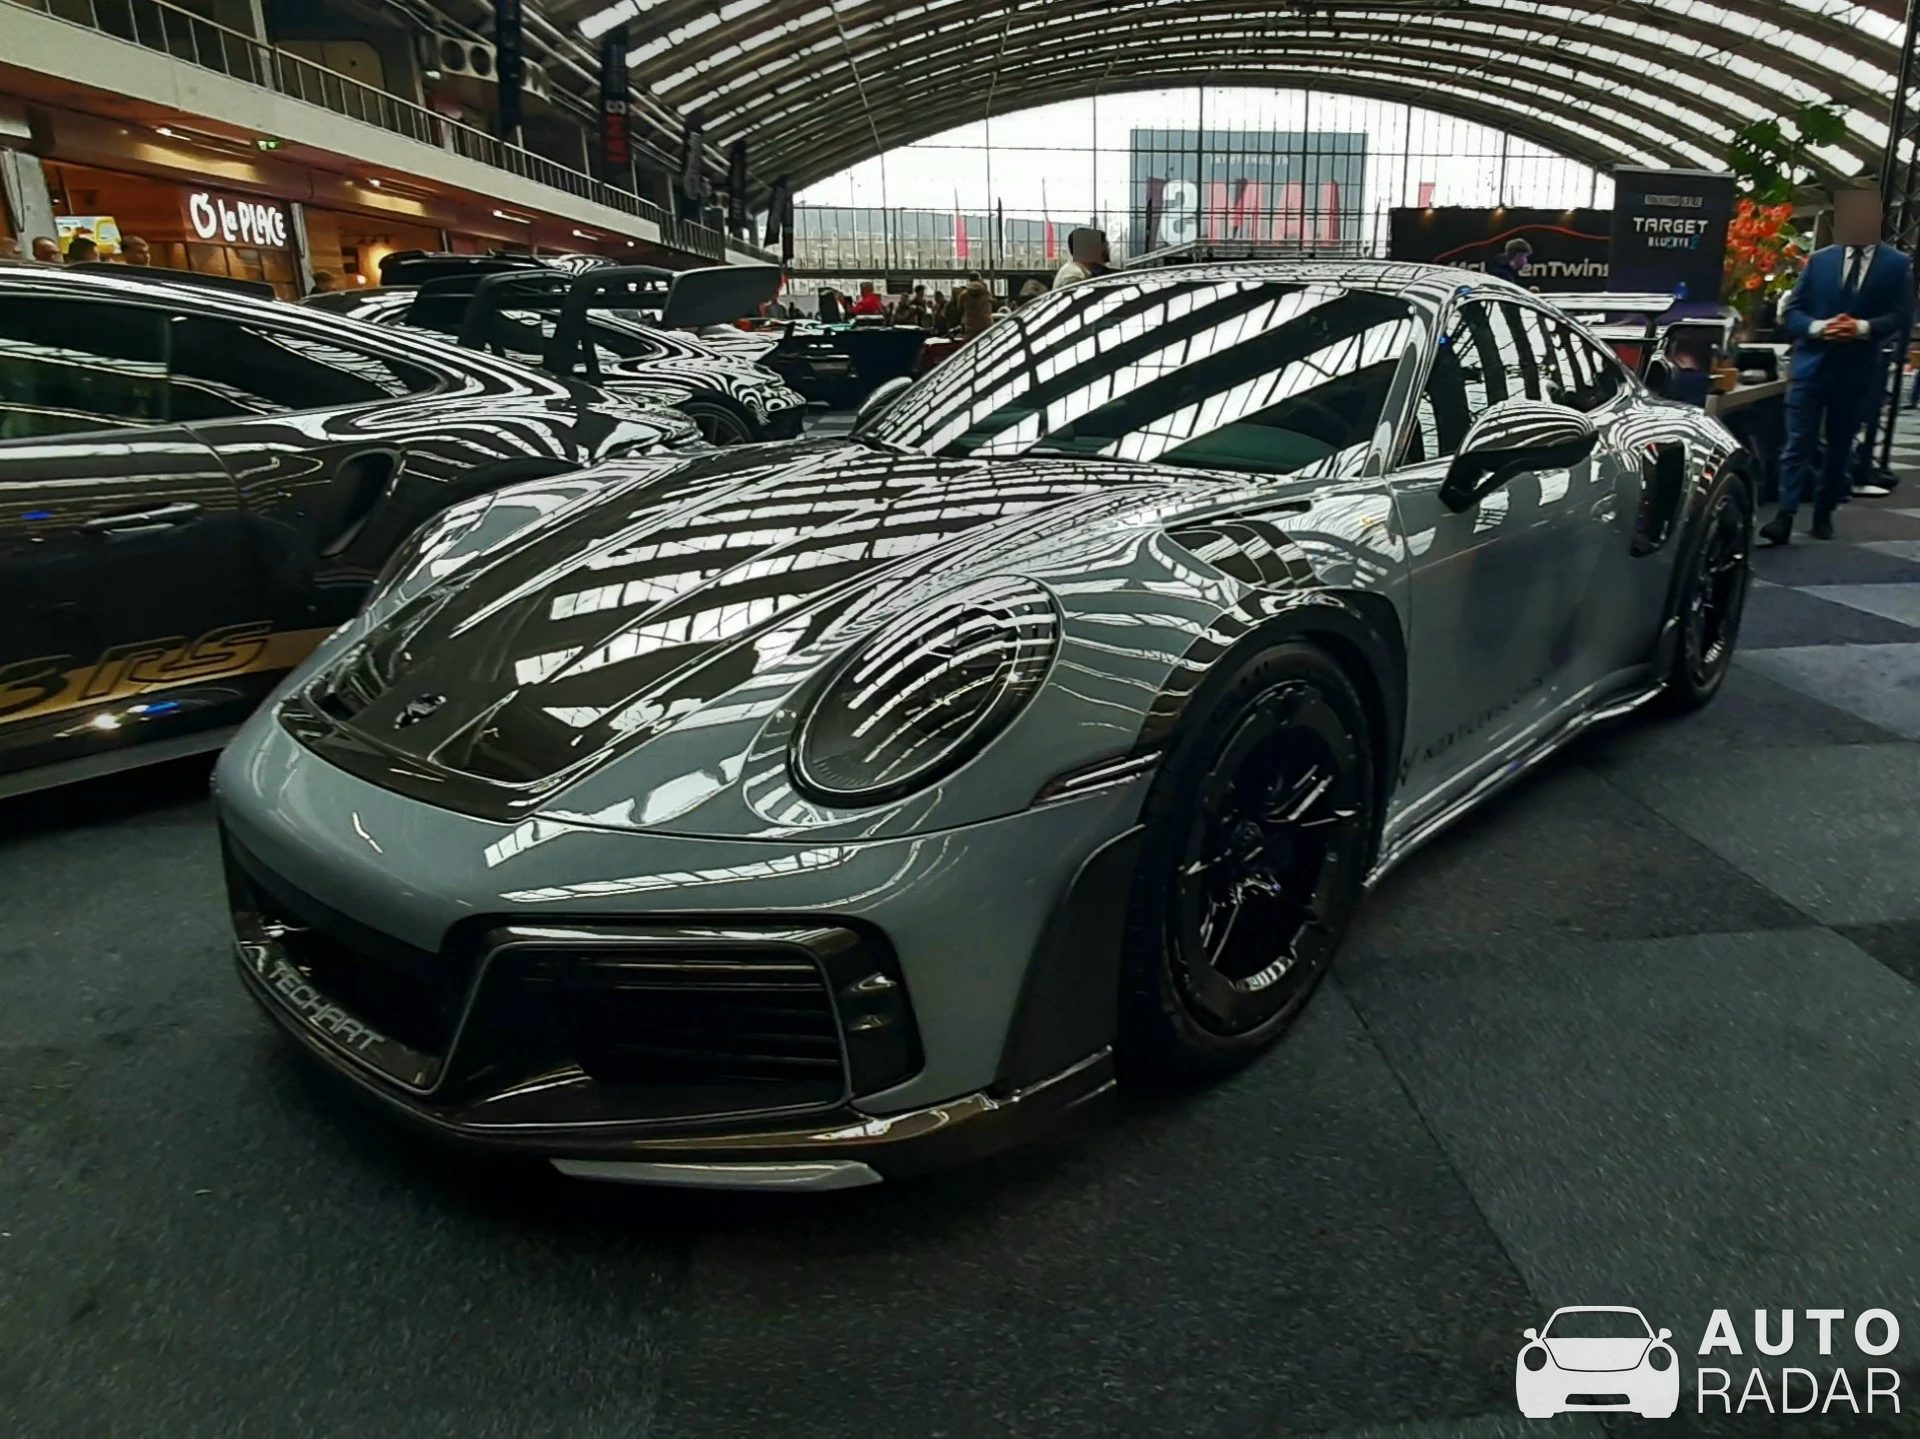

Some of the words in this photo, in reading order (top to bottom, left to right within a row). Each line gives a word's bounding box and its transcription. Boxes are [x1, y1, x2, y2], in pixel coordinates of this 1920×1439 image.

[237, 201, 287, 247] PLACE
[1633, 217, 1709, 234] TARGET
[268, 959, 385, 1050] TECHART
